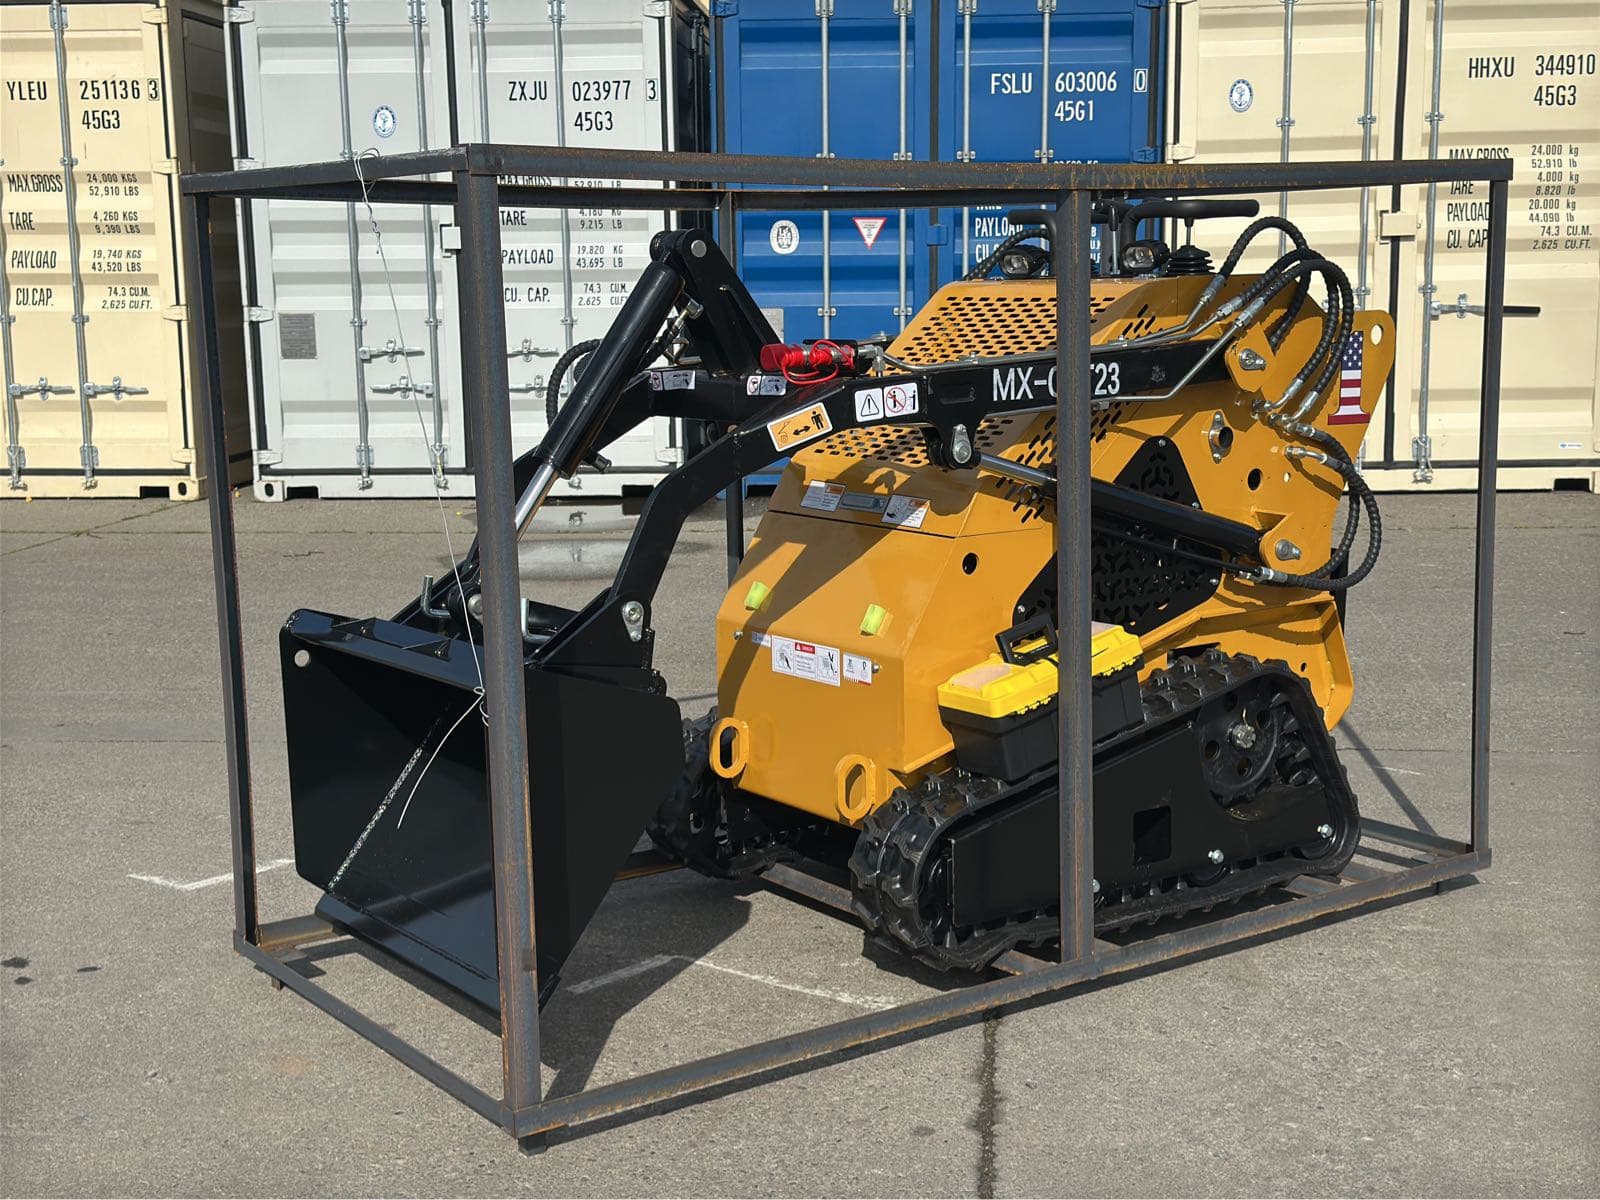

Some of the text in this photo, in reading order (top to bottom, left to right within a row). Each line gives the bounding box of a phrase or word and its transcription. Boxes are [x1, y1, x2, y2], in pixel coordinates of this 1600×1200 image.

[1469, 54, 1596, 79] HHXU 344910
[7, 79, 158, 100] YLEU 251136 3
[508, 80, 656, 101] ZXJU 023977 3
[991, 73, 1033, 94] FSLU
[1055, 71, 1117, 92] 603006
[1534, 85, 1577, 106] 45G3
[1054, 100, 1094, 122] 45G1
[82, 110, 120, 130] 45G3
[574, 111, 614, 131] 45G3
[1531, 145, 1563, 156] 24.000
[1569, 145, 1579, 156] kg
[1531, 159, 1578, 169] 52.910 lb
[122, 173, 138, 183] KGS
[1537, 171, 1563, 182] 4.000
[1570, 172, 1579, 183] kg
[89, 186, 139, 197] 52,910 LBS
[1529, 199, 1560, 210] 20.000
[1566, 199, 1576, 211] kg
[8, 212, 138, 231] TARE 4,260 KGS
[500, 210, 527, 226] TARE
[580, 220, 623, 230] 9.215 LB
[1529, 213, 1574, 223] 44.090 lb
[125, 225, 141, 234] LBS
[1447, 230, 1462, 249] CU.
[1541, 226, 1560, 237] 74.3
[1566, 226, 1593, 236] CU.M.
[1532, 240, 1558, 250] 2.625
[11, 251, 57, 269] PAYLOAD
[126, 250, 142, 259] KGS
[502, 245, 623, 264] PAYLOAD 19.820 KG
[91, 262, 142, 272] 43,520 LBS
[576, 258, 623, 268] 43.695 LB
[108, 287, 127, 297] 74.3
[504, 287, 522, 303] CU.
[527, 287, 550, 302] CAP.
[584, 283, 601, 294] 74.3
